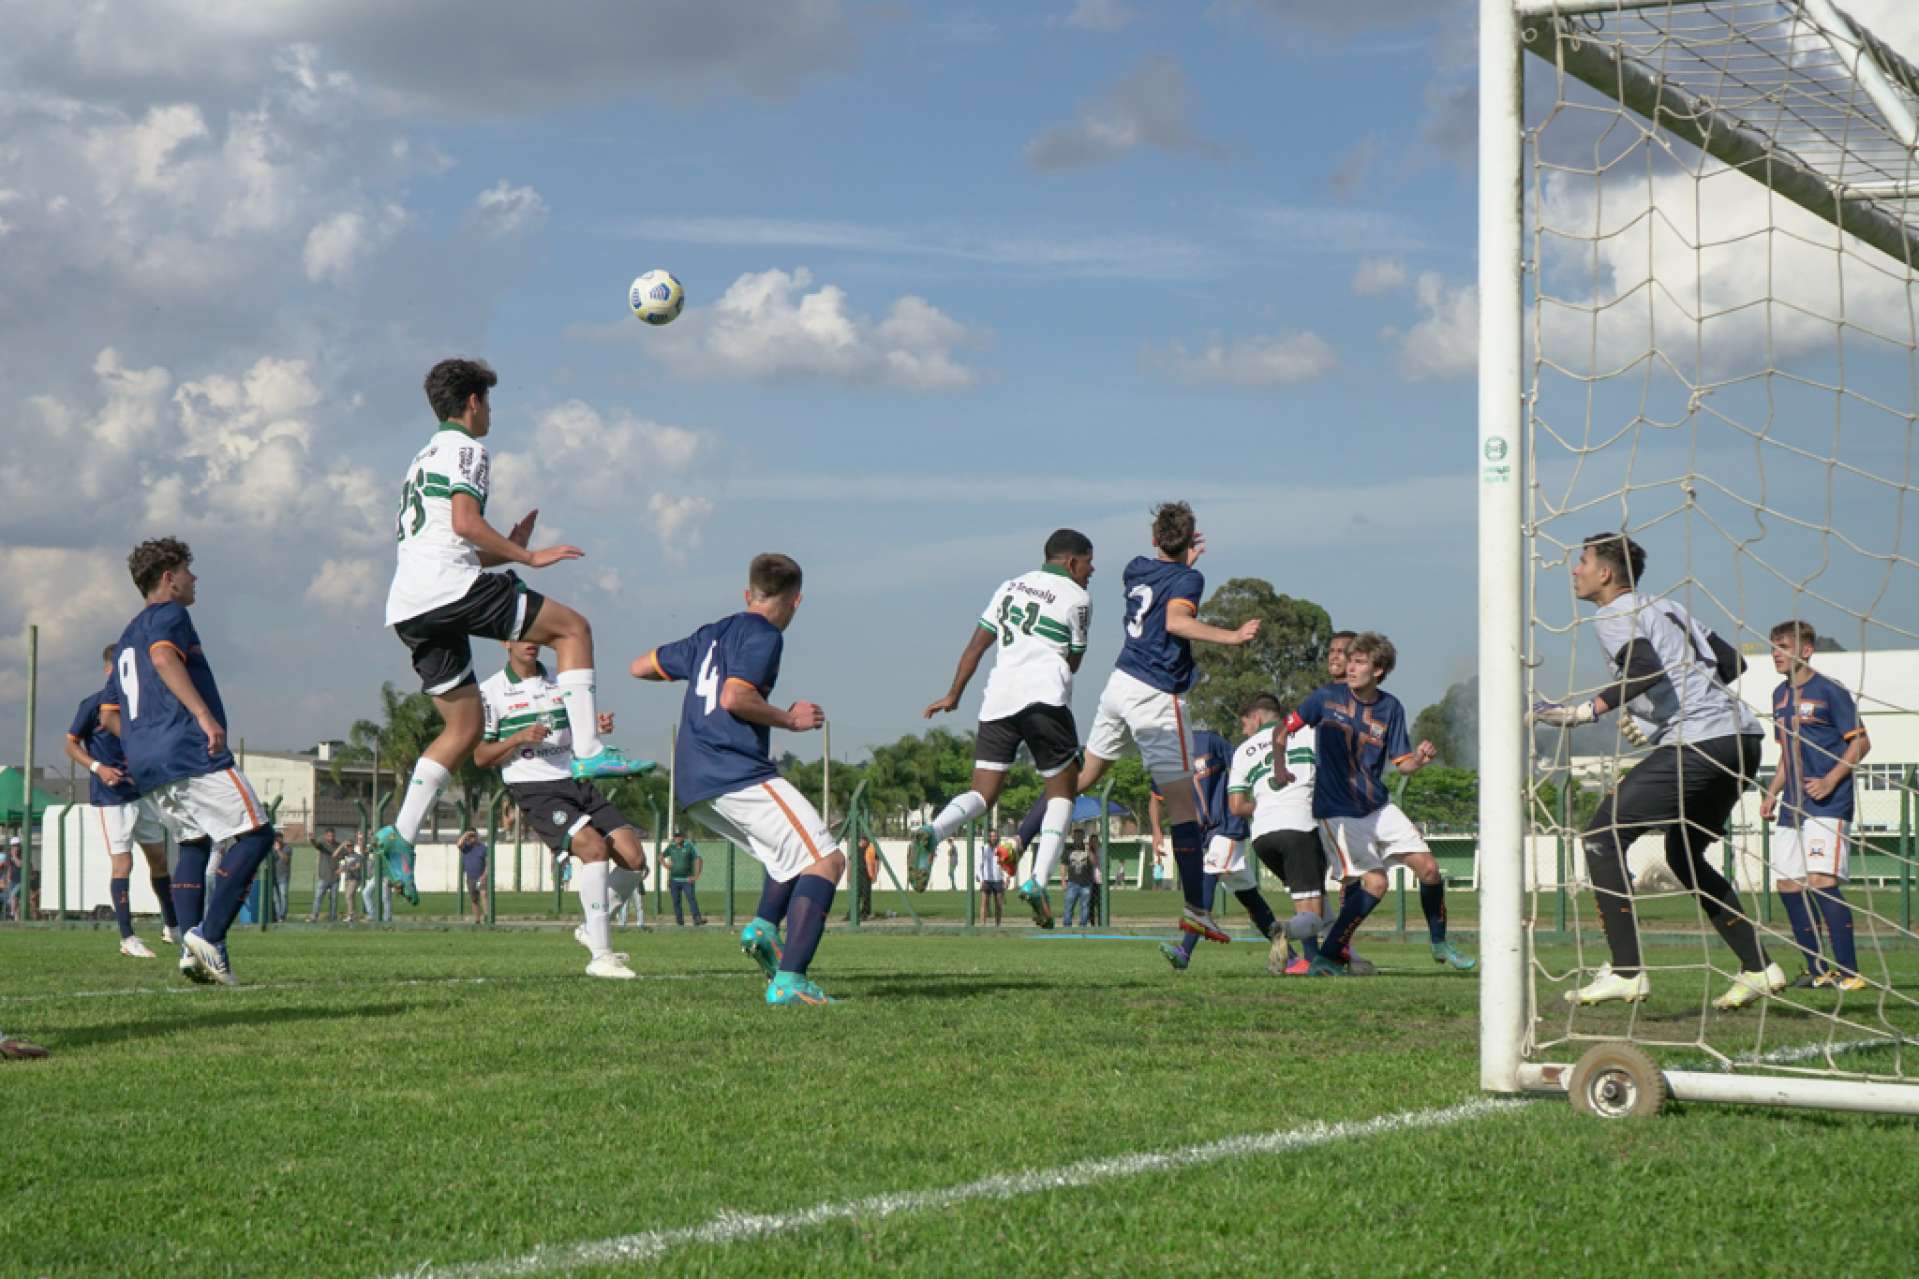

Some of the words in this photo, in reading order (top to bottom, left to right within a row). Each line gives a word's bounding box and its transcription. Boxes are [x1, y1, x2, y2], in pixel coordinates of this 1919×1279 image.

[1127, 583, 1153, 638] 3
[117, 647, 139, 721] 9
[695, 639, 719, 716] 4
